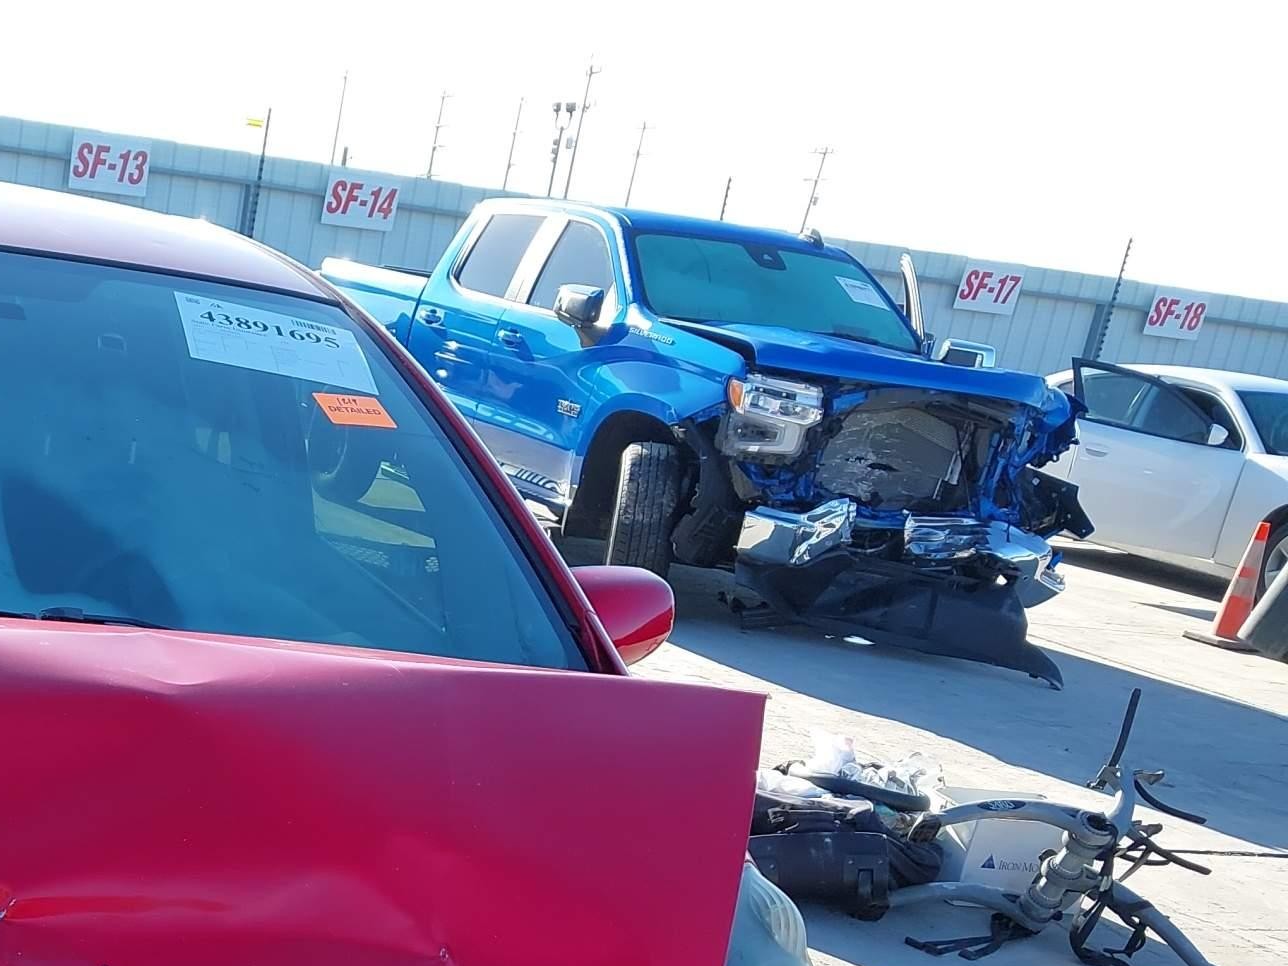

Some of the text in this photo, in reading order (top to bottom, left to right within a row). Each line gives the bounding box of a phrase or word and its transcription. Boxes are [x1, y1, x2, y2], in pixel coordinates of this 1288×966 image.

[72, 142, 148, 185] SF-13
[326, 180, 398, 220] SF-14
[959, 269, 1021, 304] SF-17
[200, 310, 341, 349] 43891695
[1148, 297, 1206, 331] SF-18
[328, 405, 382, 416] DETAILED
